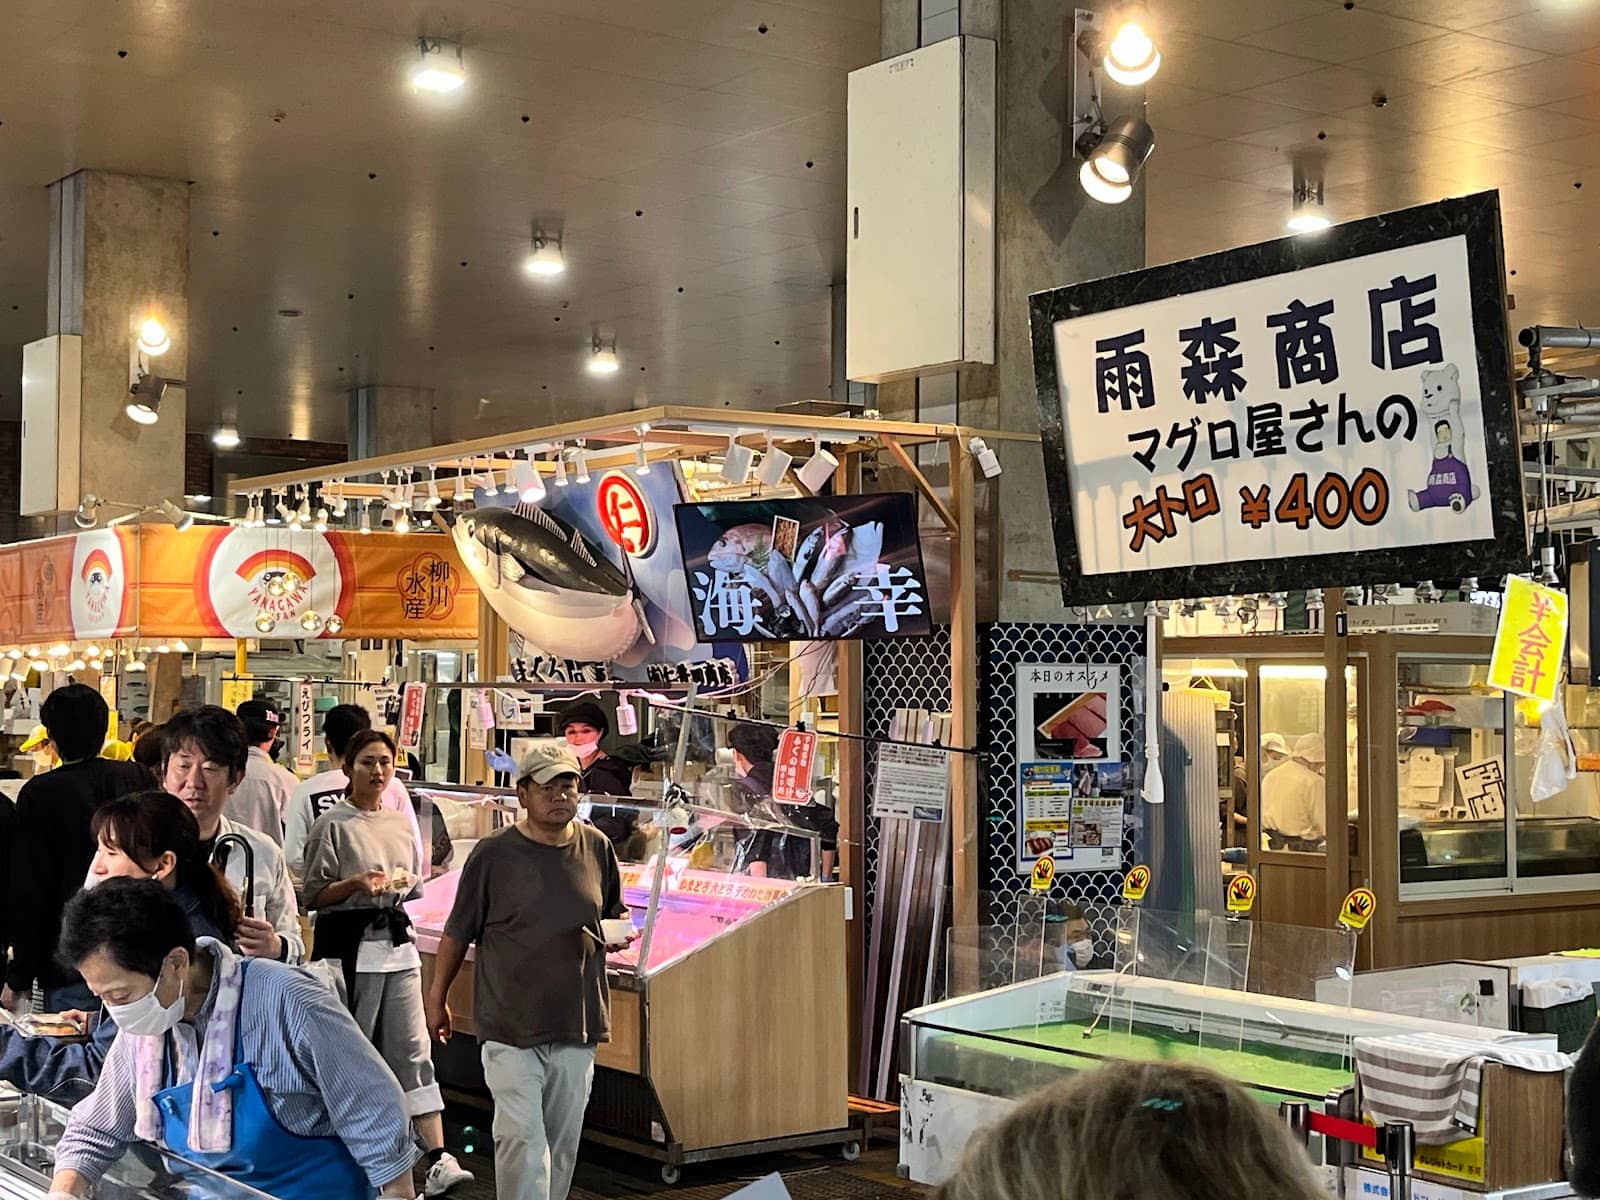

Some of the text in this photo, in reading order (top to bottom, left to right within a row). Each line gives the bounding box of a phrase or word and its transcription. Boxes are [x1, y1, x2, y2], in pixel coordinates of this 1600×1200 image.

[1095, 273, 1444, 413] 雨森商店
[1127, 392, 1418, 473] マグロ屋さんの
[1122, 467, 1390, 552] 大トロ ¥400
[404, 571, 426, 619] 水産
[430, 560, 450, 607] 柳川
